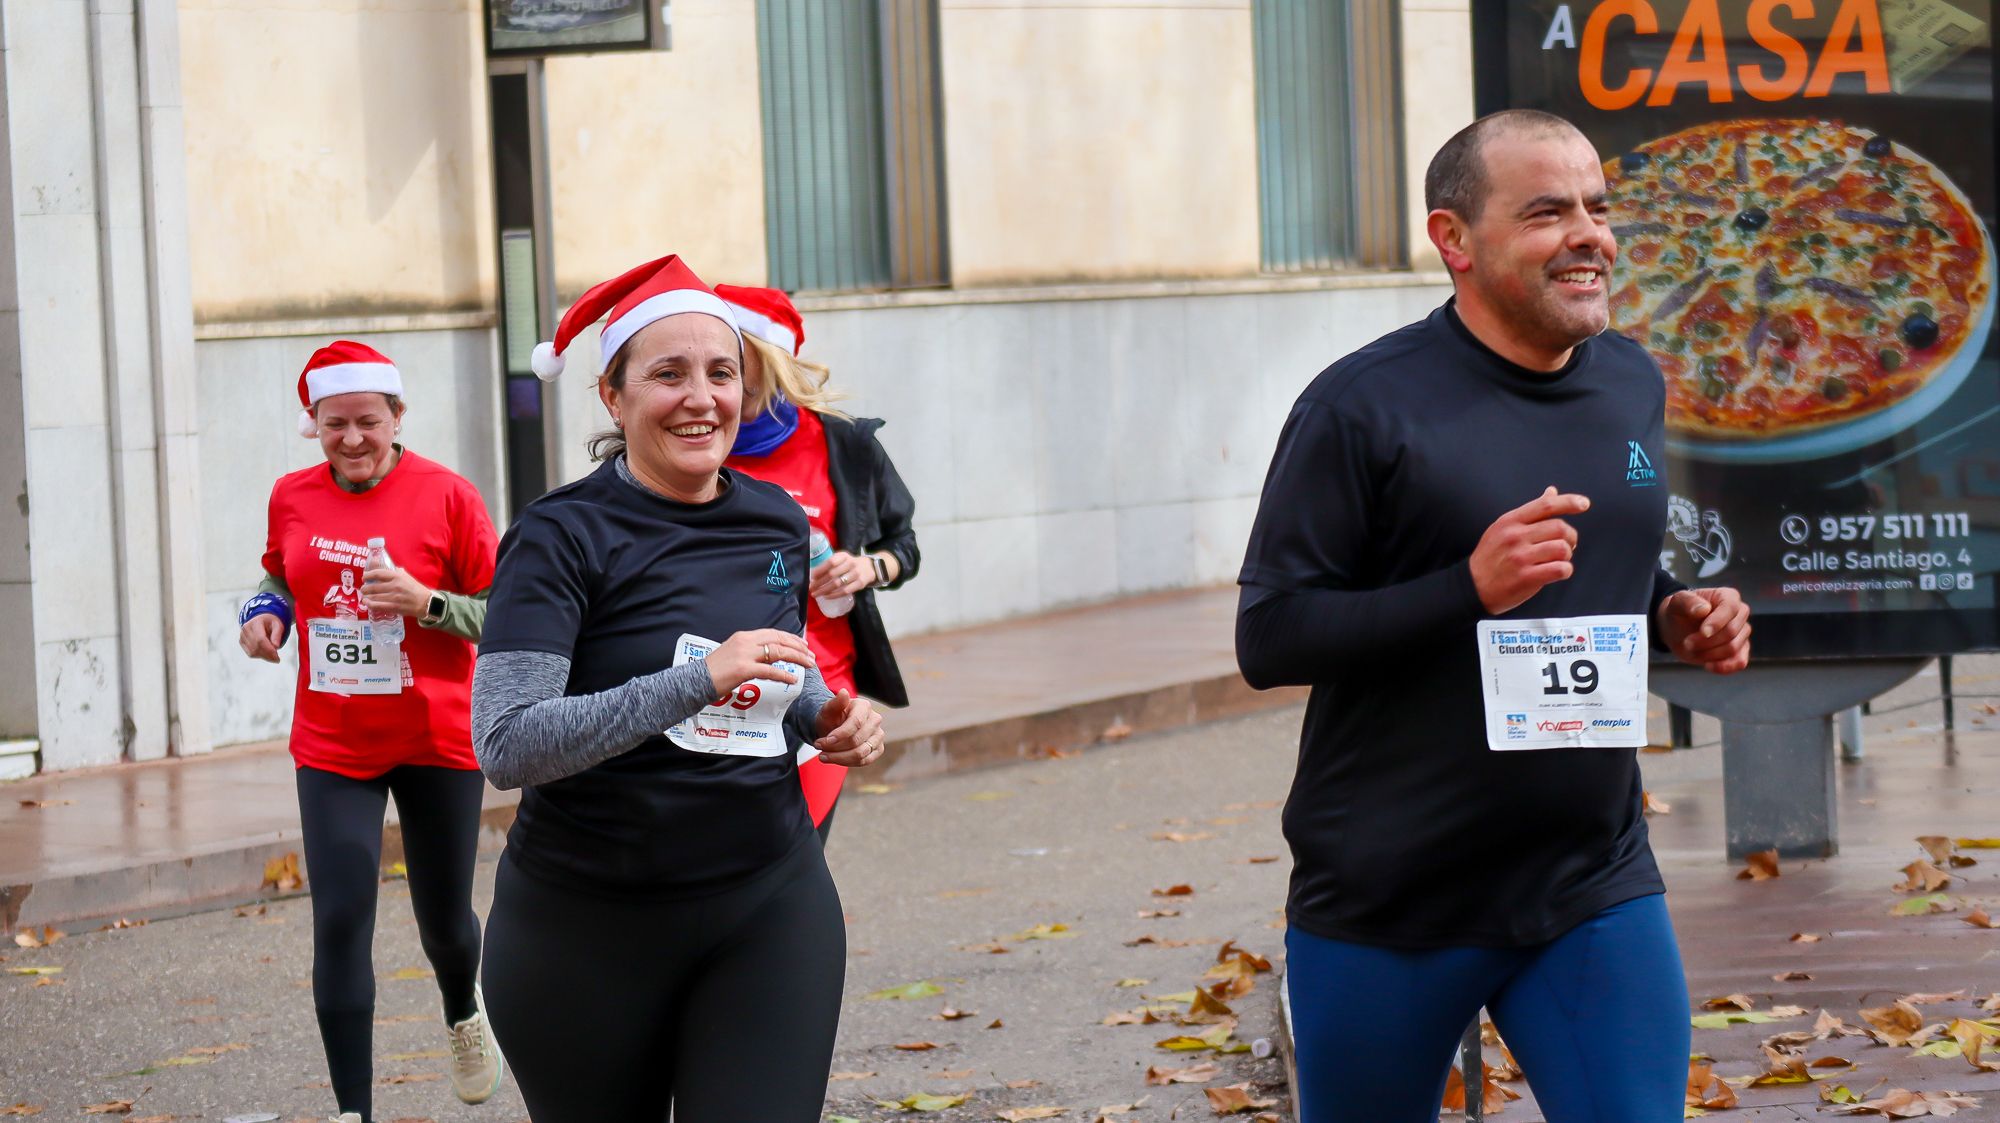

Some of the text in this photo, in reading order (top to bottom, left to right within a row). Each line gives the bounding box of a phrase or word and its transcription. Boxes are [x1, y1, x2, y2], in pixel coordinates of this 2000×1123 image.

[1542, 0, 1891, 110] A CASA
[1820, 513, 1969, 541] 957 511 111
[316, 537, 334, 550] San
[334, 540, 370, 557] Silvestr
[319, 549, 366, 568] Ciudad de
[1782, 551, 1839, 571] Calle
[1957, 548, 1972, 566] 4
[1782, 577, 1912, 594] pericotepizzeria.com
[315, 631, 332, 639] Ciudad
[1498, 634, 1518, 644] San
[325, 643, 378, 665] 631
[689, 647, 704, 659] San
[1498, 644, 1534, 655] Ciudad
[1550, 643, 1586, 655] Lucena
[1541, 659, 1599, 695] 19
[1592, 718, 1632, 728] enerplus
[735, 729, 768, 739] enerplus
